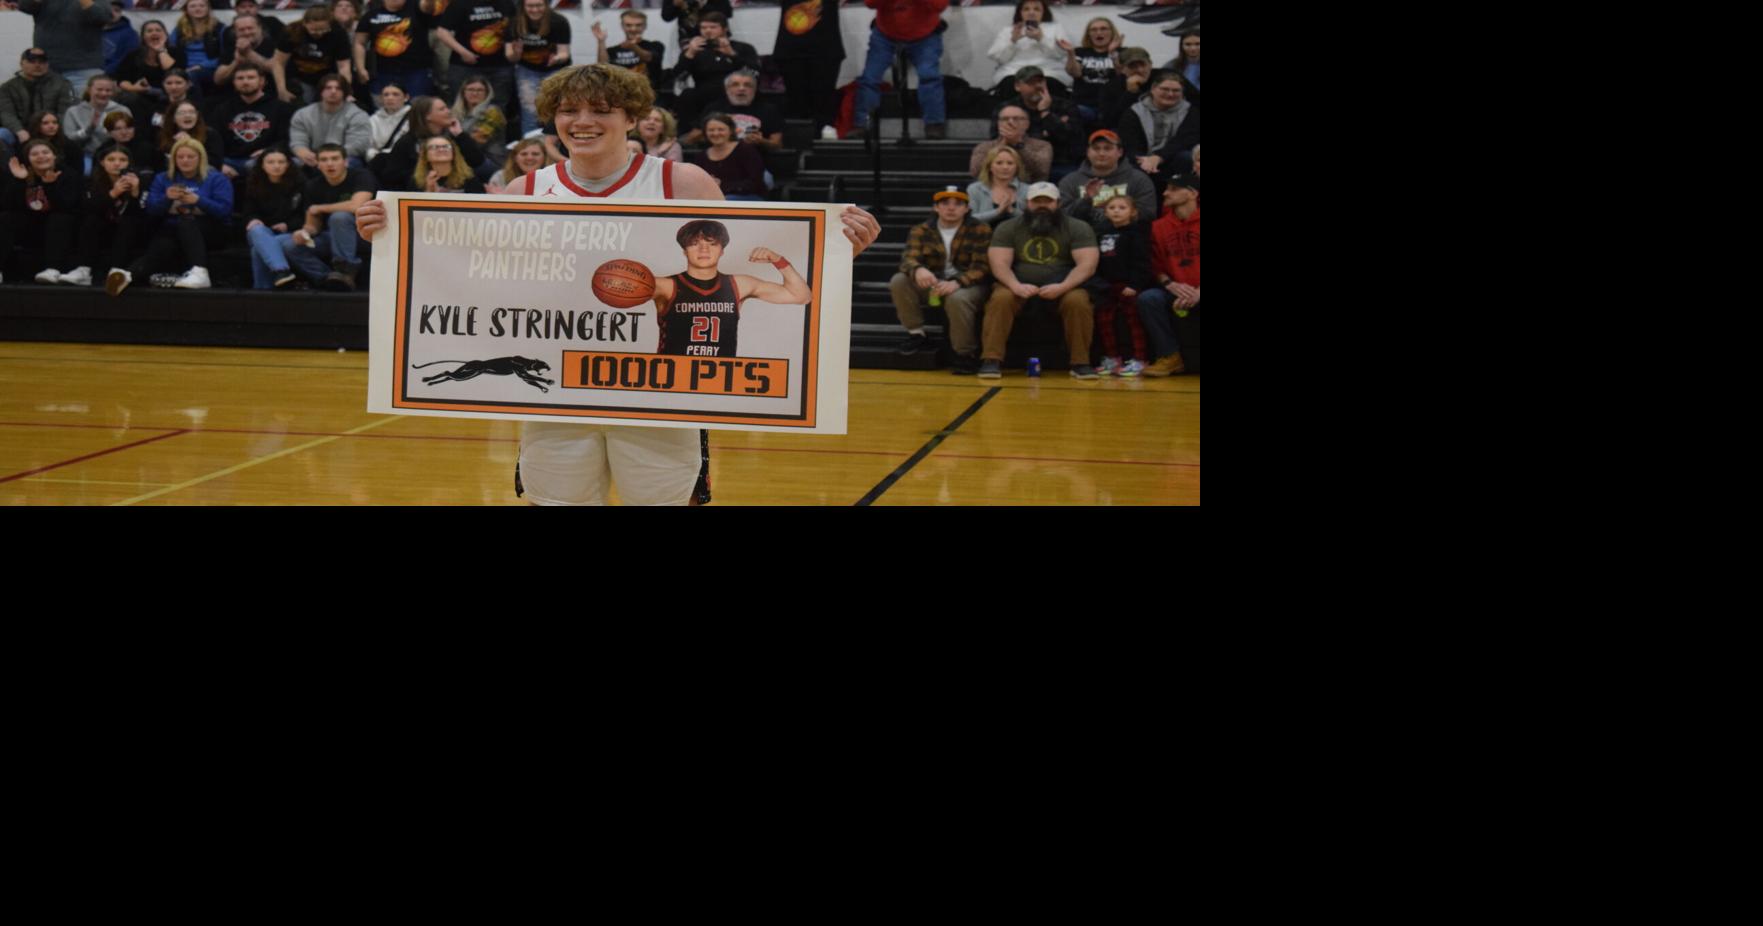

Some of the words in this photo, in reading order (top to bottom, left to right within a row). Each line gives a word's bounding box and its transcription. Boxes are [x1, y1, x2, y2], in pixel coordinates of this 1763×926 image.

[421, 216, 555, 250] COMMODORE
[561, 221, 632, 251] PERRY
[468, 250, 577, 282] PANTHERS
[419, 304, 478, 336] KYLE
[489, 307, 646, 343] STRINGERT
[675, 302, 735, 313] COMMODORE
[690, 316, 720, 342] 21
[686, 345, 720, 356] PERRY
[580, 355, 675, 389] 1000
[690, 359, 770, 394] PTS
